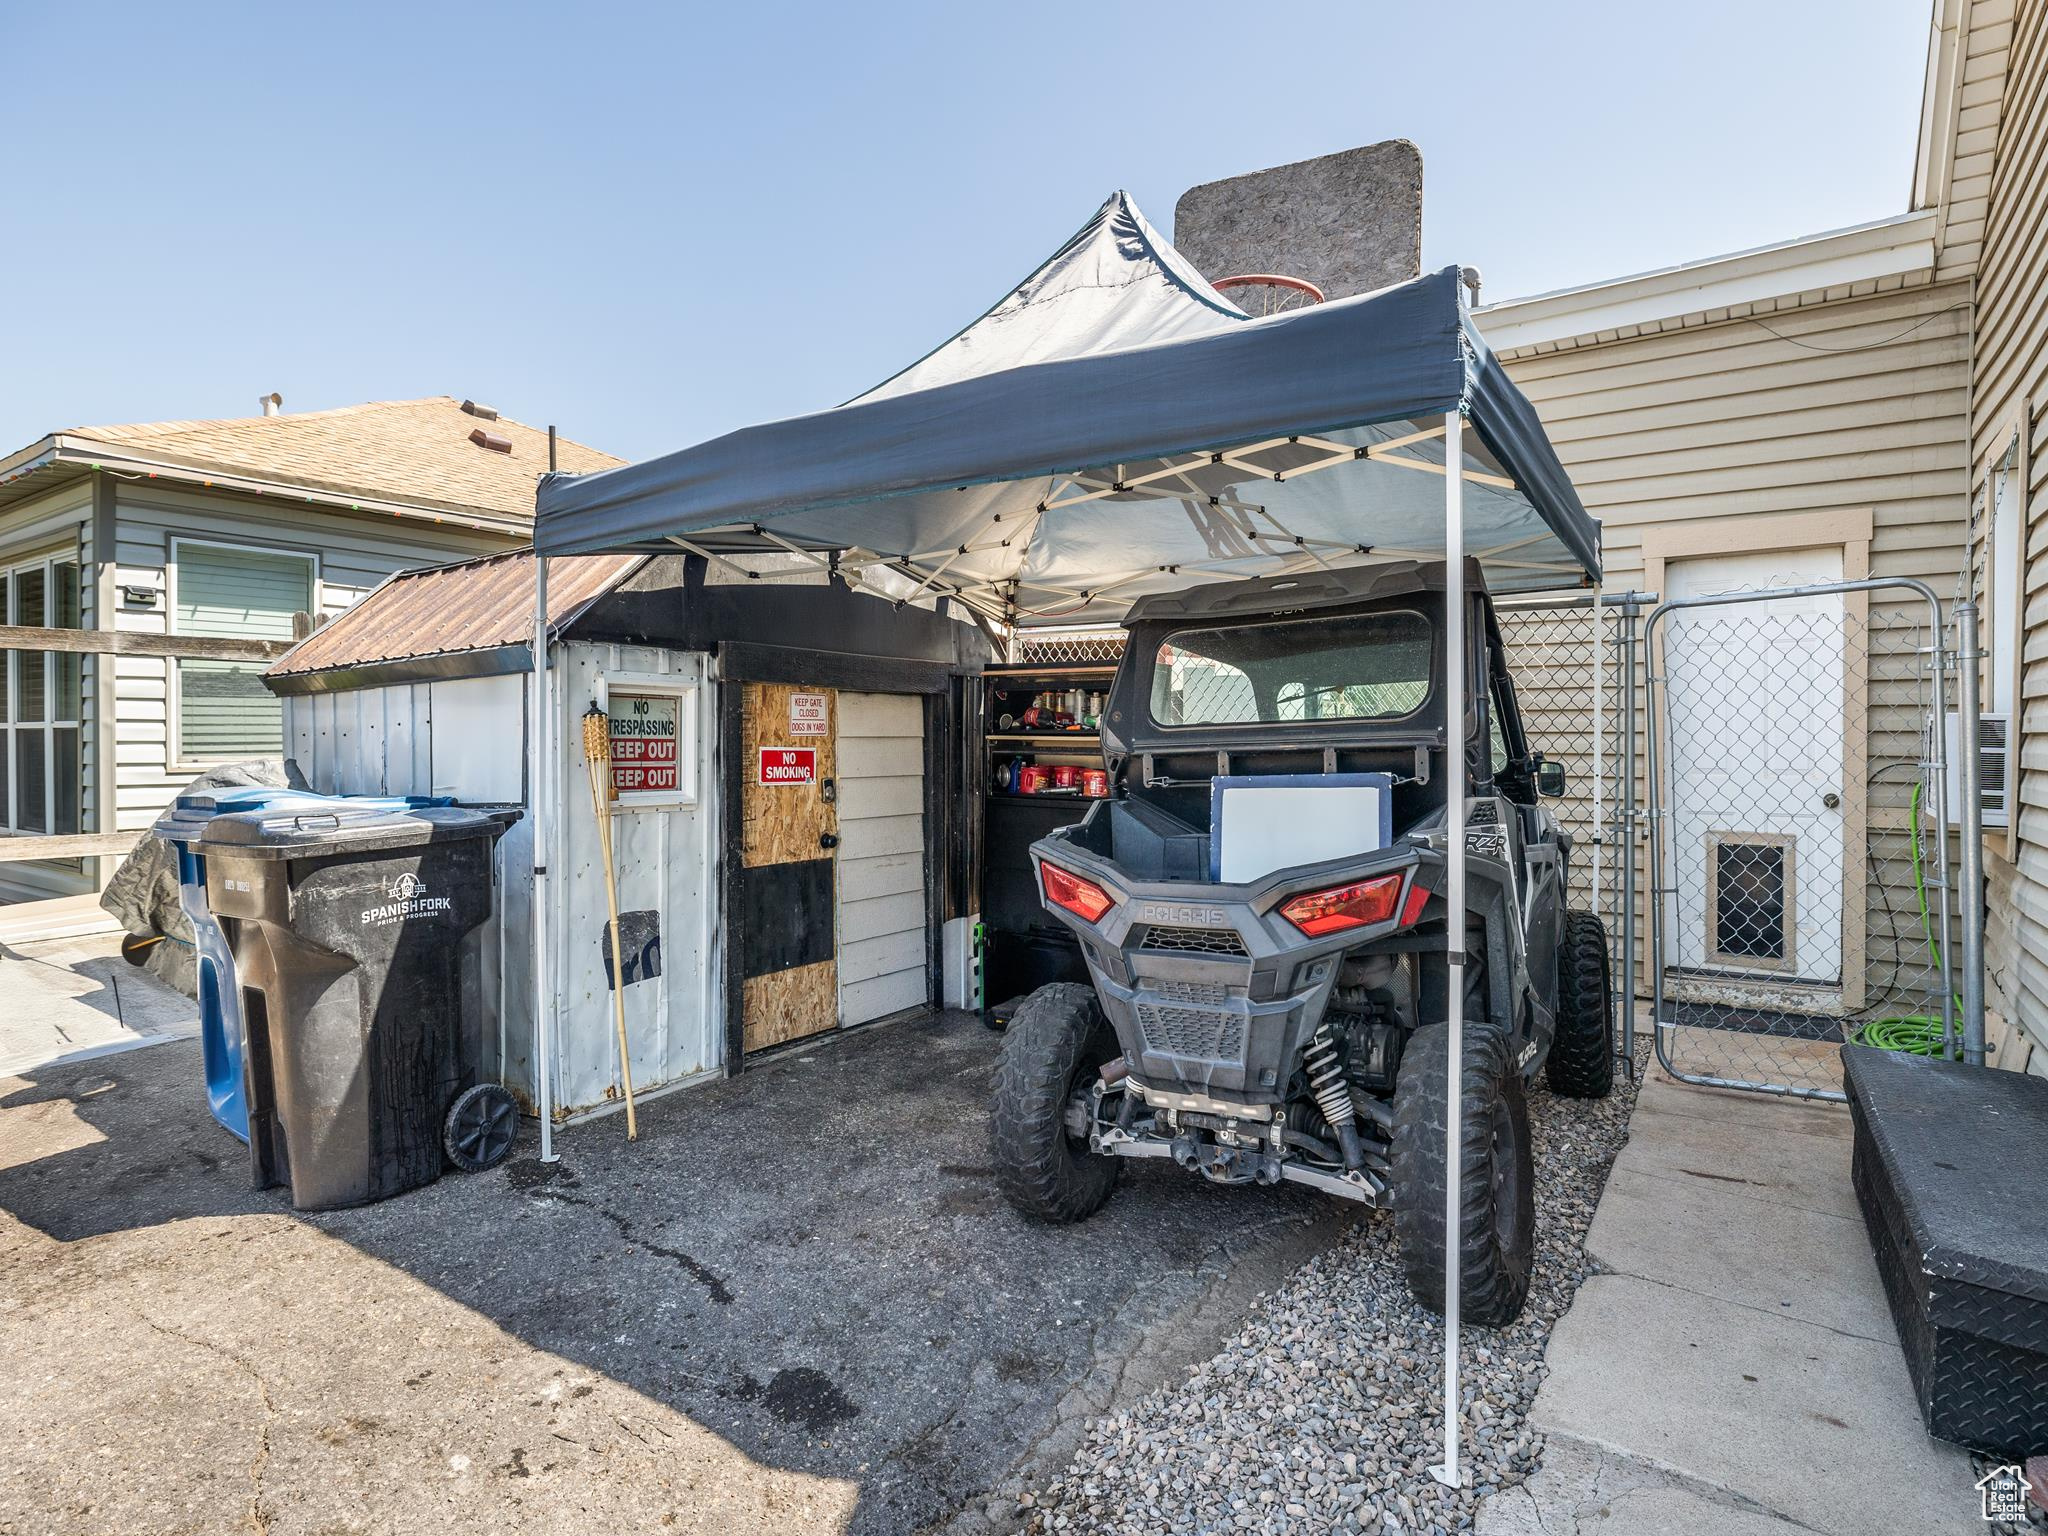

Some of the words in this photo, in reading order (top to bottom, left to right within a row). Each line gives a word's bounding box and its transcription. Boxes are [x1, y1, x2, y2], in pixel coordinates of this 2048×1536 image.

[633, 700, 649, 715] NO
[794, 698, 808, 707] KEEP
[809, 698, 823, 708] GATE
[798, 708, 819, 718] CLOSED
[608, 719, 674, 736] TRESPASSING
[791, 722, 806, 732] DOGS
[806, 722, 812, 732] IN
[813, 722, 826, 732] YARD
[648, 741, 675, 759] OUT
[782, 752, 796, 765] NO
[647, 769, 674, 786] OUT
[765, 765, 811, 779] SMOKING
[361, 899, 418, 924] SPANISH
[420, 897, 452, 911] FORK
[377, 916, 398, 927] PRIDE
[406, 910, 439, 920] PROGRESS
[1143, 905, 1224, 925] POLARIS
